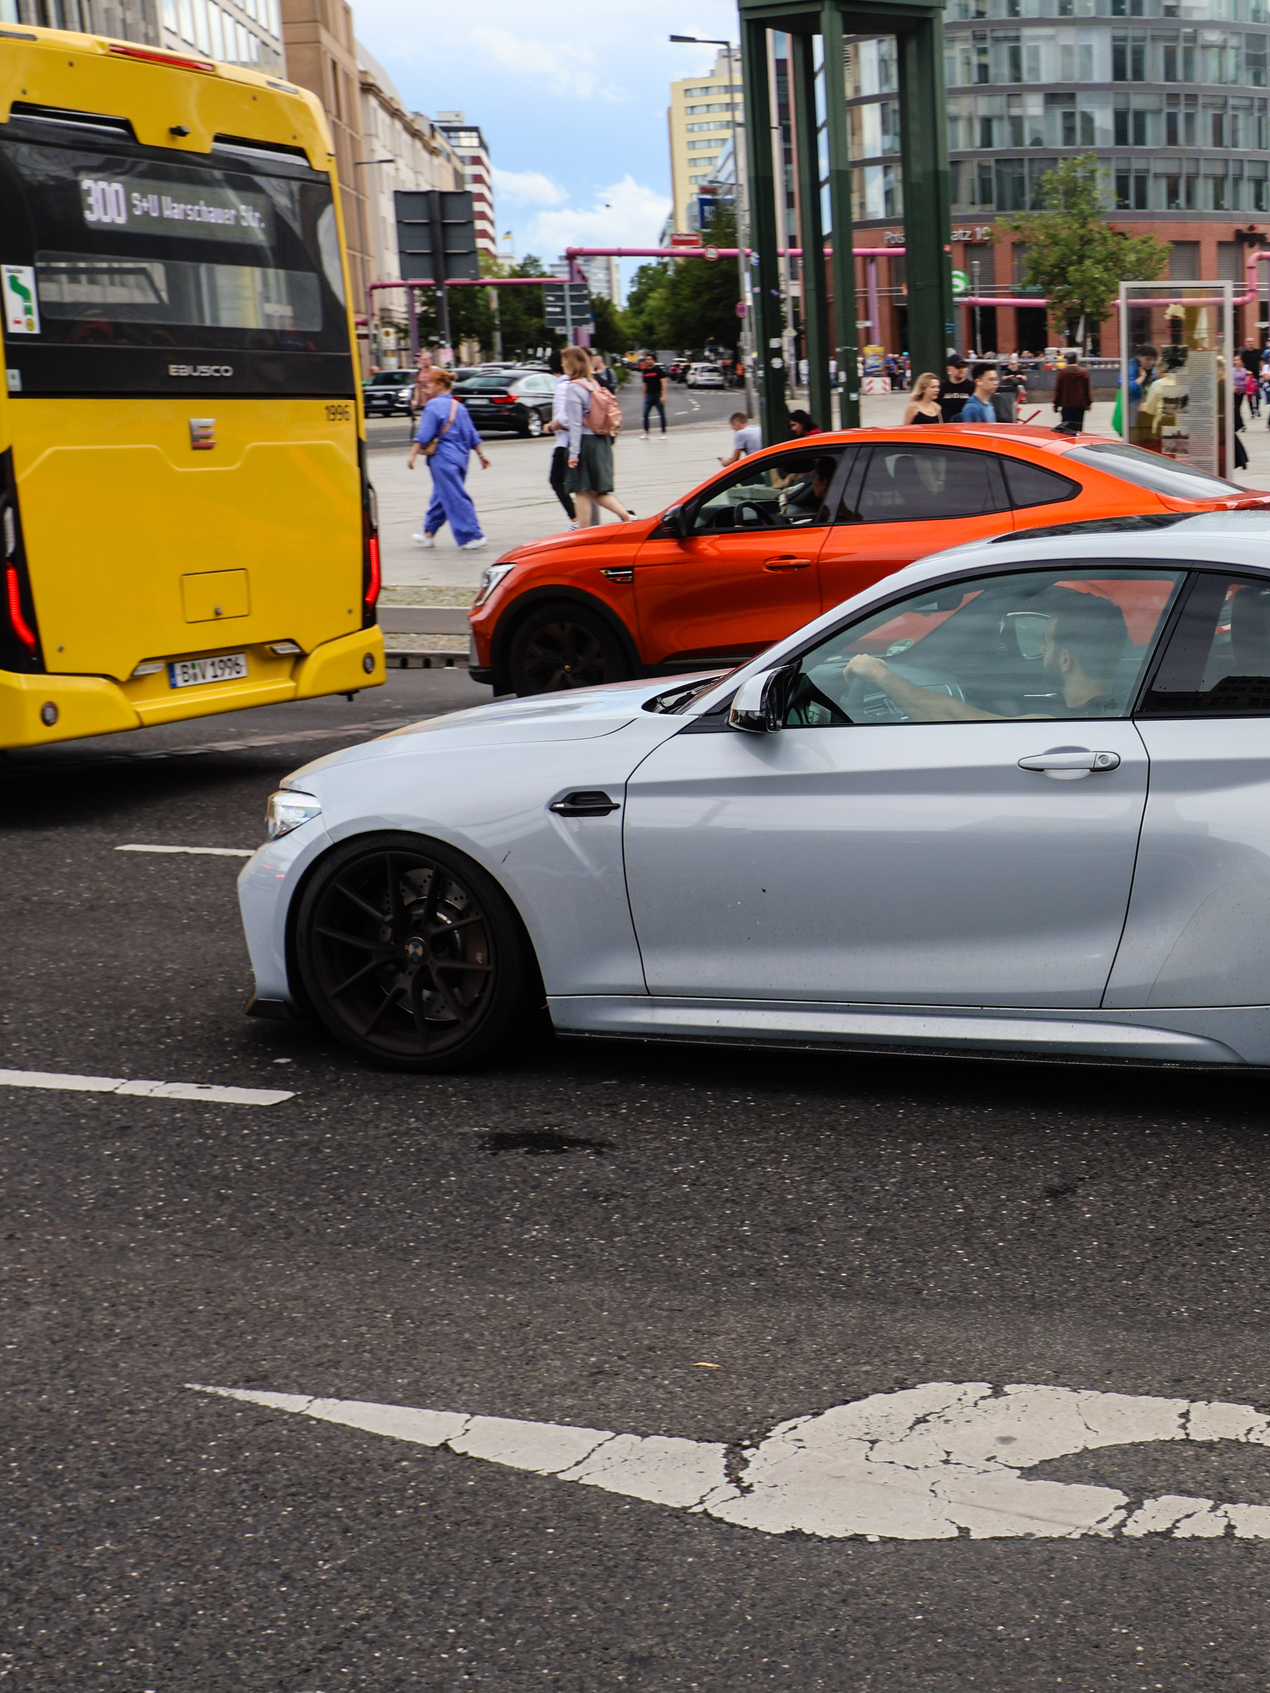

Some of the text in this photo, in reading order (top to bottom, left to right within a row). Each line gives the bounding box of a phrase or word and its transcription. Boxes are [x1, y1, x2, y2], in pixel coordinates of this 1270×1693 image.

[82, 179, 266, 228] 300 S+U Warschauer Str.
[168, 364, 234, 376] EBUSCO
[325, 404, 350, 421] 1996
